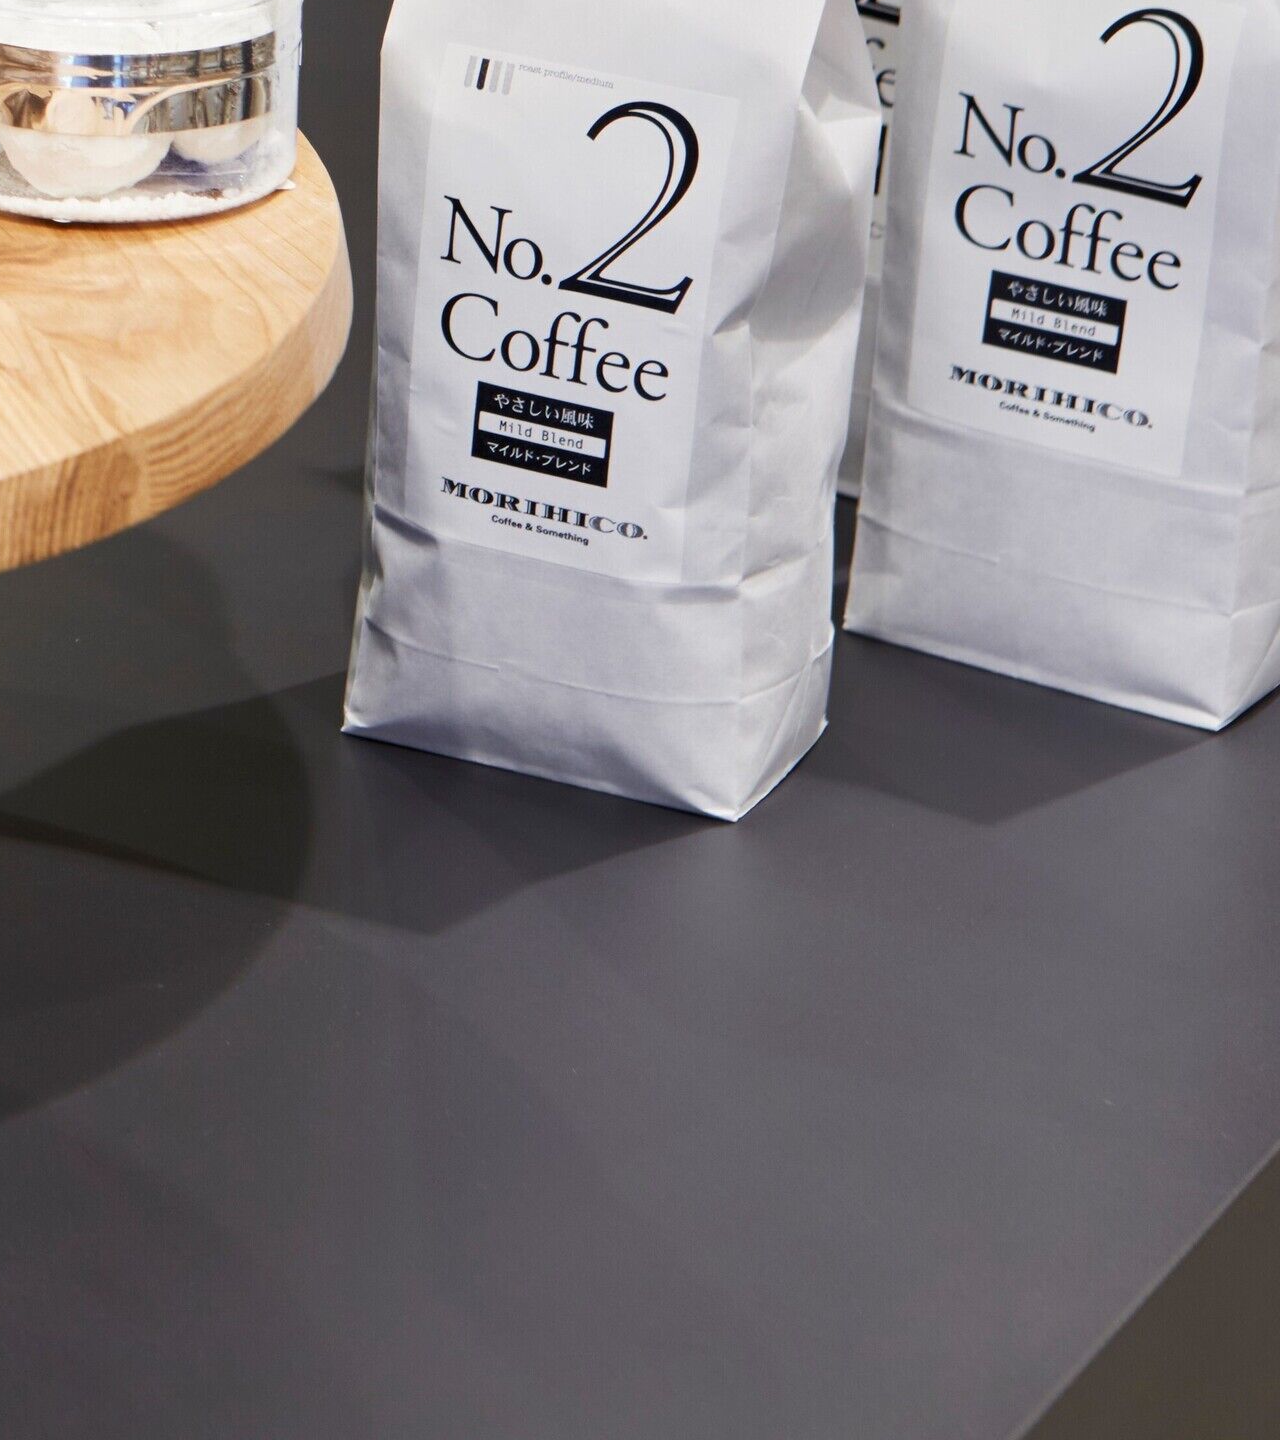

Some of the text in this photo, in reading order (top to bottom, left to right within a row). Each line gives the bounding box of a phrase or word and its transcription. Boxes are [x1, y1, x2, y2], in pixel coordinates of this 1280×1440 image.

[953, 8, 1204, 209] No.2
[440, 101, 699, 315] No.2
[954, 183, 1182, 291] Coffee
[1007, 280, 1109, 318] やさしい風味
[1010, 309, 1097, 337] Mild Blend
[440, 292, 669, 402] Coffee
[494, 393, 594, 430] やさしい風味
[949, 363, 1154, 430] MORIHICO.
[499, 420, 584, 449] Mild Blend
[999, 400, 1030, 416] Coffee
[1042, 411, 1096, 433] Something
[487, 441, 592, 476] マイルド・ブレンド
[440, 476, 648, 540] MORIHICO.
[491, 514, 590, 546] Coffee & Something
